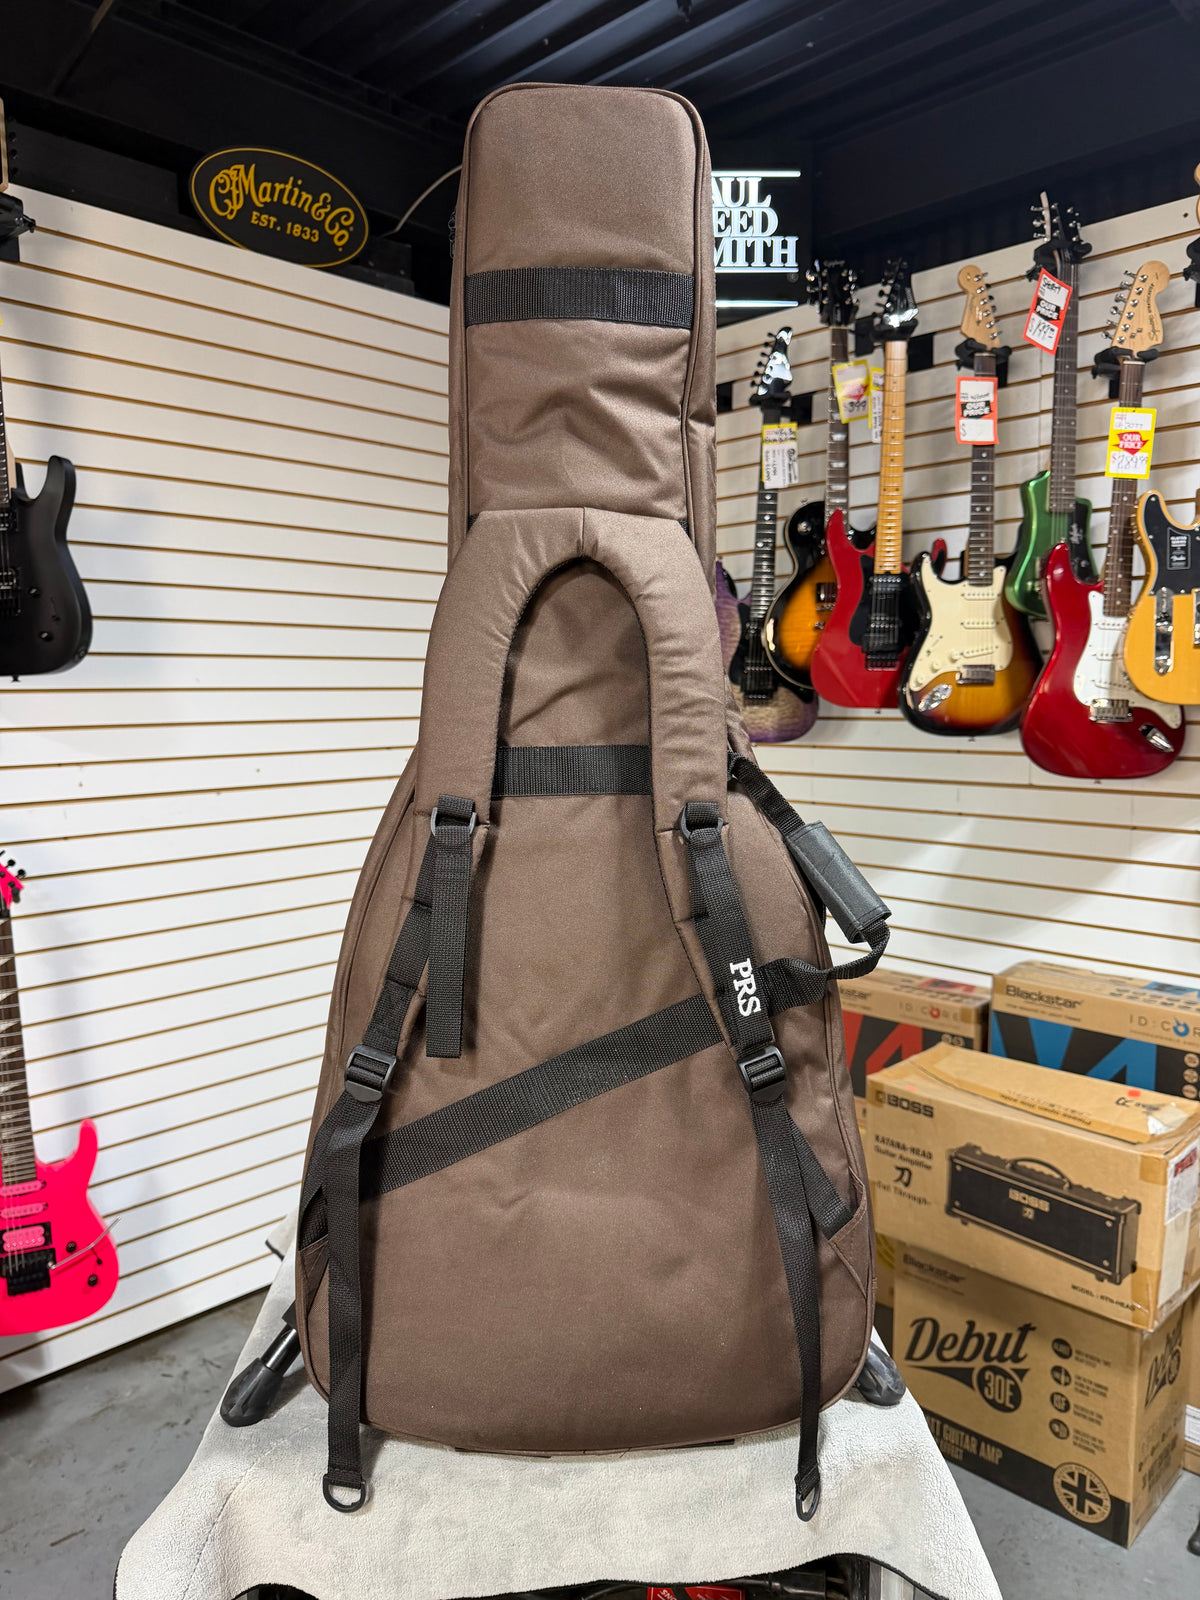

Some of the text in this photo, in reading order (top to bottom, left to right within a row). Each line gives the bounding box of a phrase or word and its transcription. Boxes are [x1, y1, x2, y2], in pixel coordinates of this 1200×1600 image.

[711, 176, 772, 208] AUL
[251, 211, 319, 242] EST. 1833
[712, 207, 779, 238] EED
[713, 236, 799, 268] MITH
[1035, 305, 1059, 320] PRICE
[1040, 300, 1057, 312] OUR
[1119, 440, 1143, 449] PRICE
[1122, 433, 1141, 442] OUR
[729, 958, 761, 1017] PRS
[1006, 984, 1084, 1009] Blackstar
[887, 1094, 934, 1119] BOSS
[904, 1317, 1037, 1364] Debut
[983, 1370, 1016, 1410] 30E
[979, 1440, 1003, 1465] AMP
